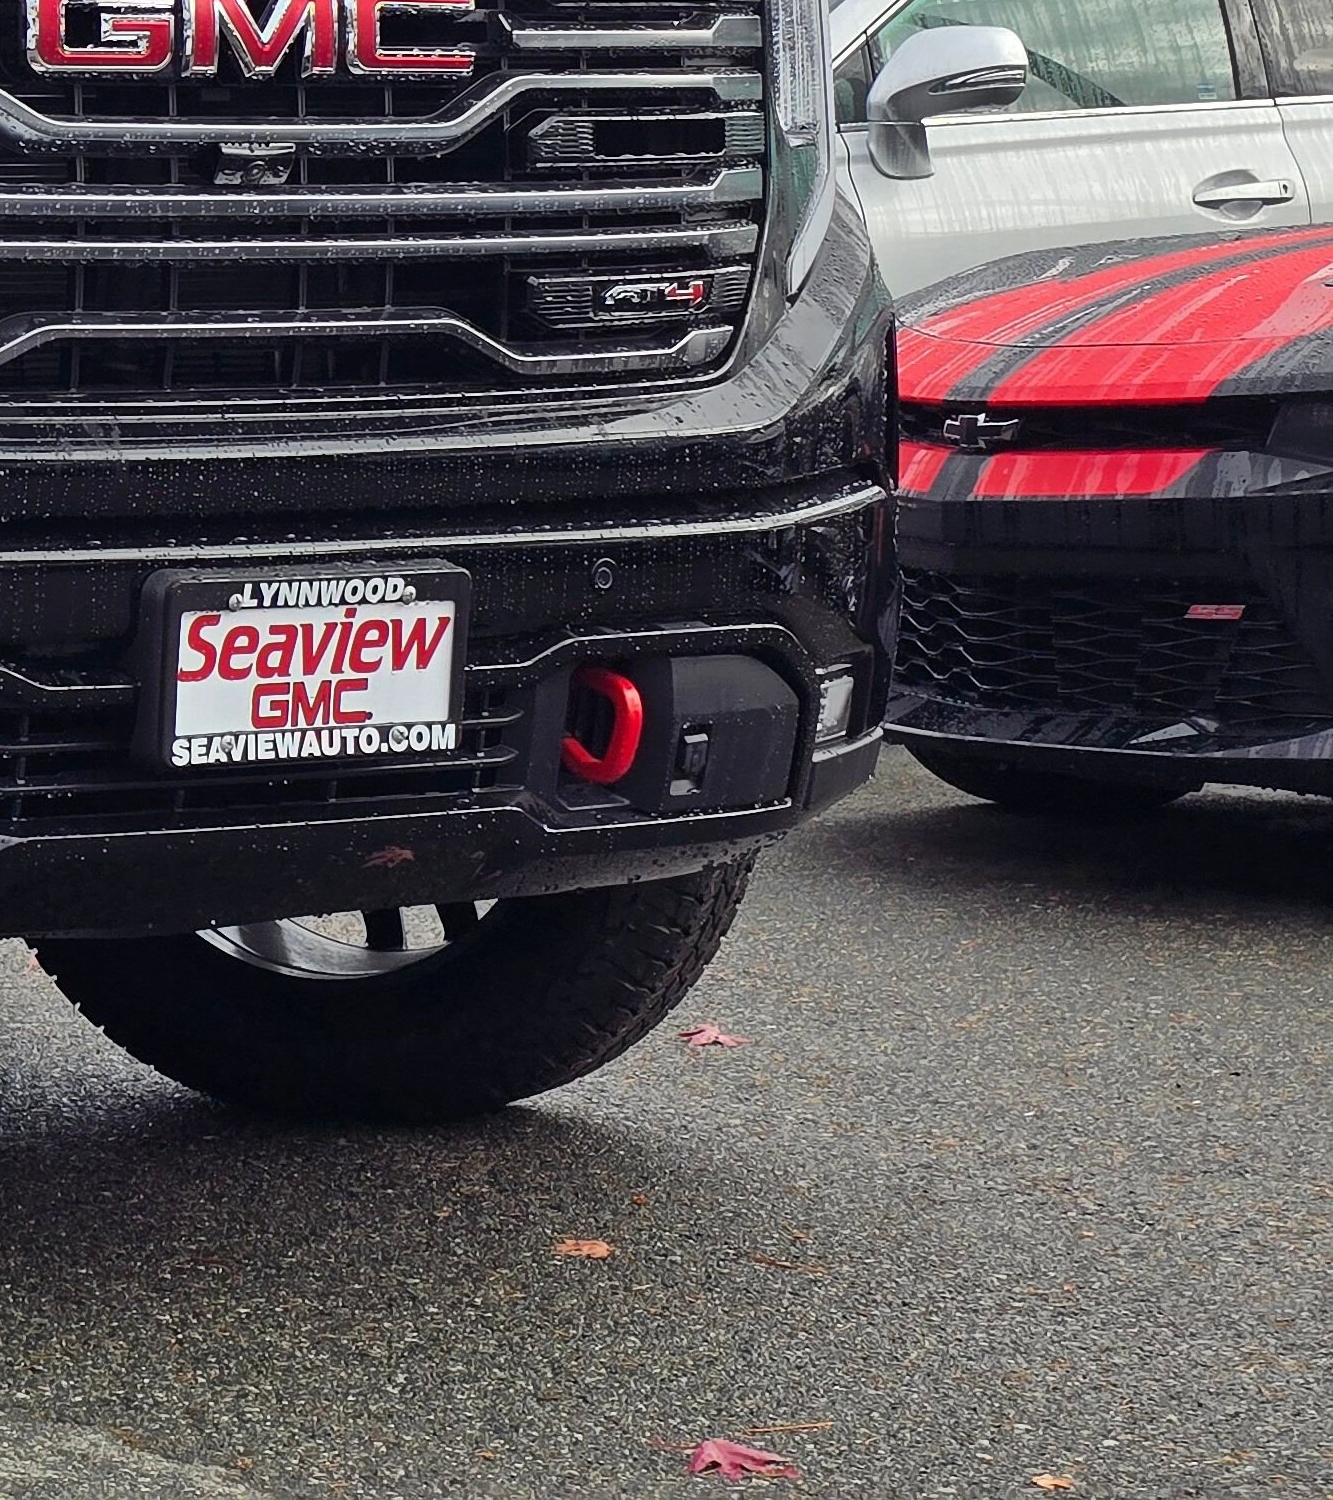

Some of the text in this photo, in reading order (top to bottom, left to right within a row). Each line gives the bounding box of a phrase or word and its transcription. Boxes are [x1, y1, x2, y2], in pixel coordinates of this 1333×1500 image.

[241, 577, 406, 607] LYNNWOOD
[177, 607, 451, 682] Seaview
[251, 678, 369, 729] GMC
[171, 724, 456, 766] SEAVIEWAUTO.COM
